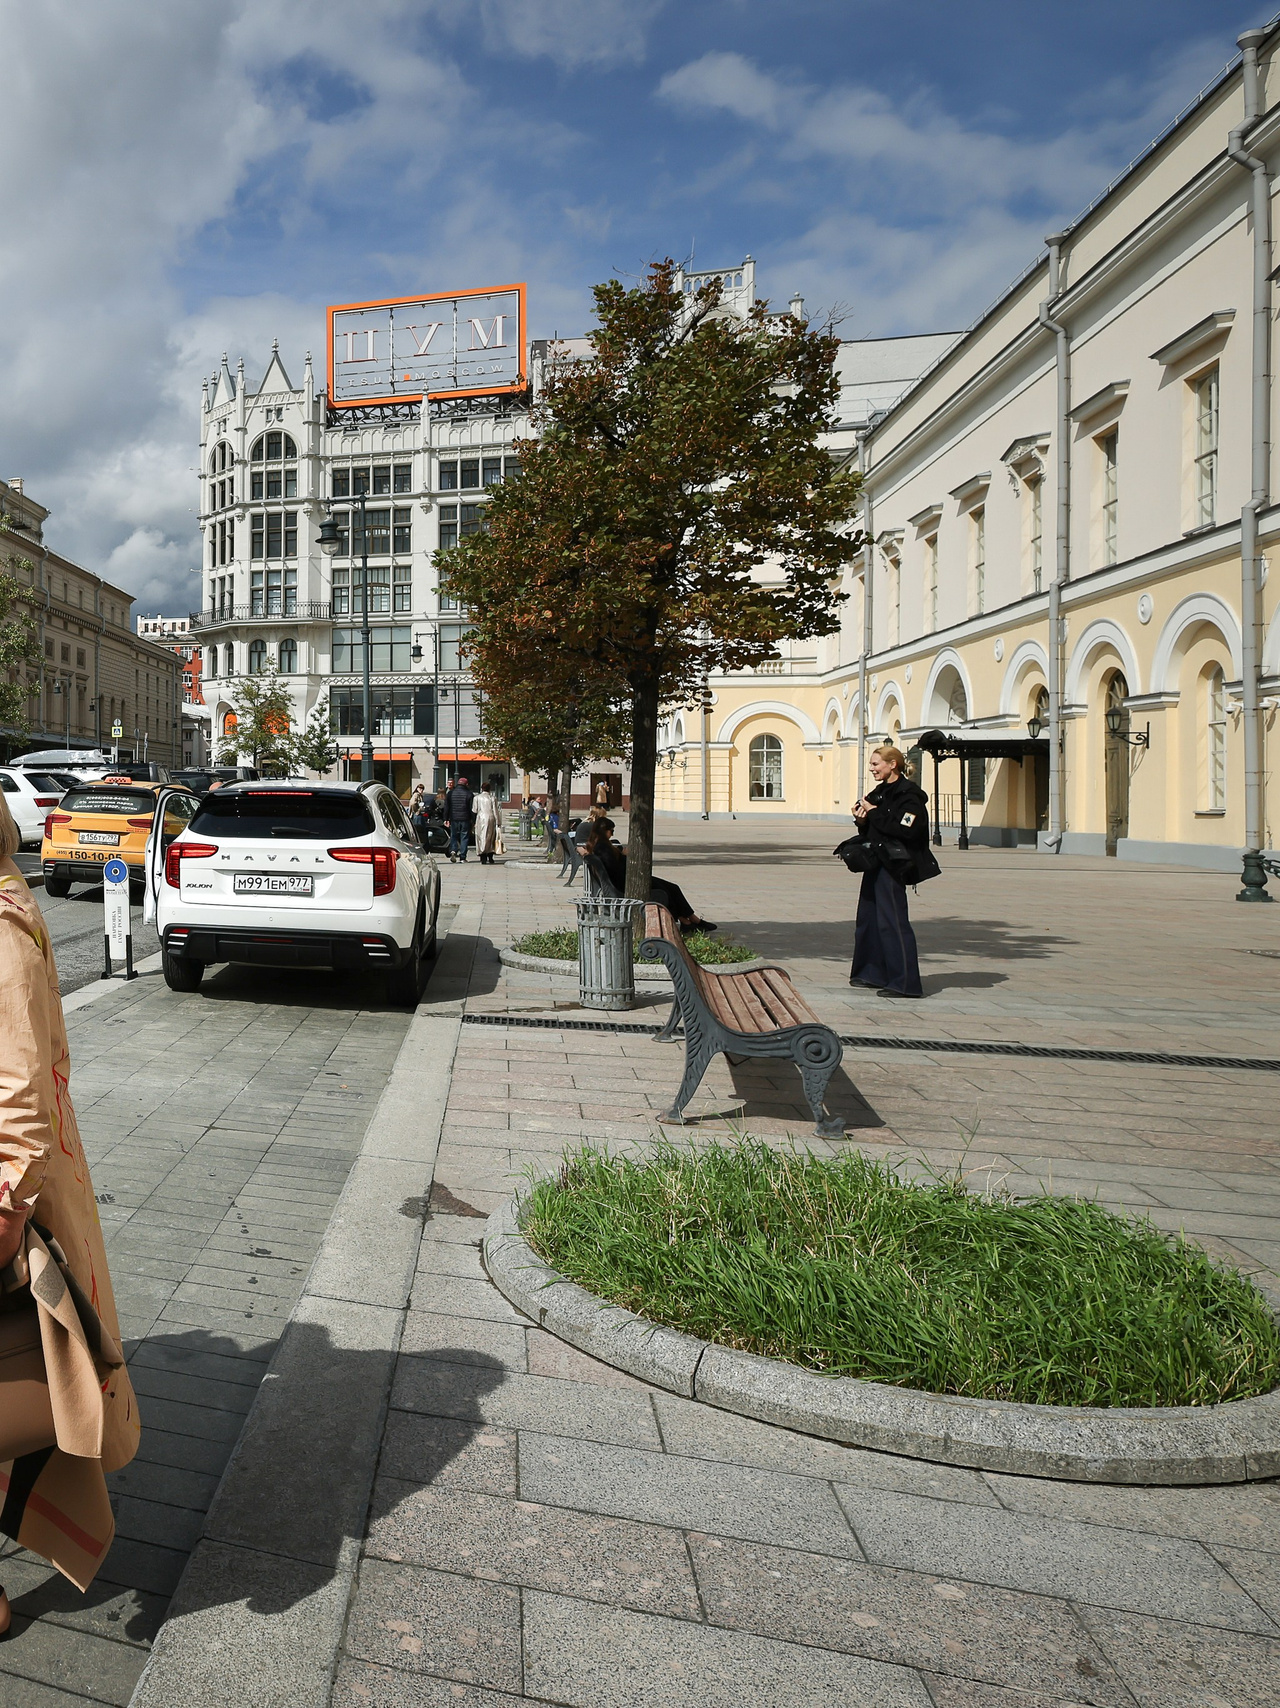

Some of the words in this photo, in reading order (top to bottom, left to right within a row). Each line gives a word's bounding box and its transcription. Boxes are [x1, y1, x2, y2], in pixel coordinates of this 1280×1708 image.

[343, 315, 508, 363] ЦУМ
[348, 373, 398, 386] TSUM
[415, 364, 503, 380] MOSCOW
[68, 850, 122, 861] 150-10-05
[221, 854, 324, 863] HAVAL
